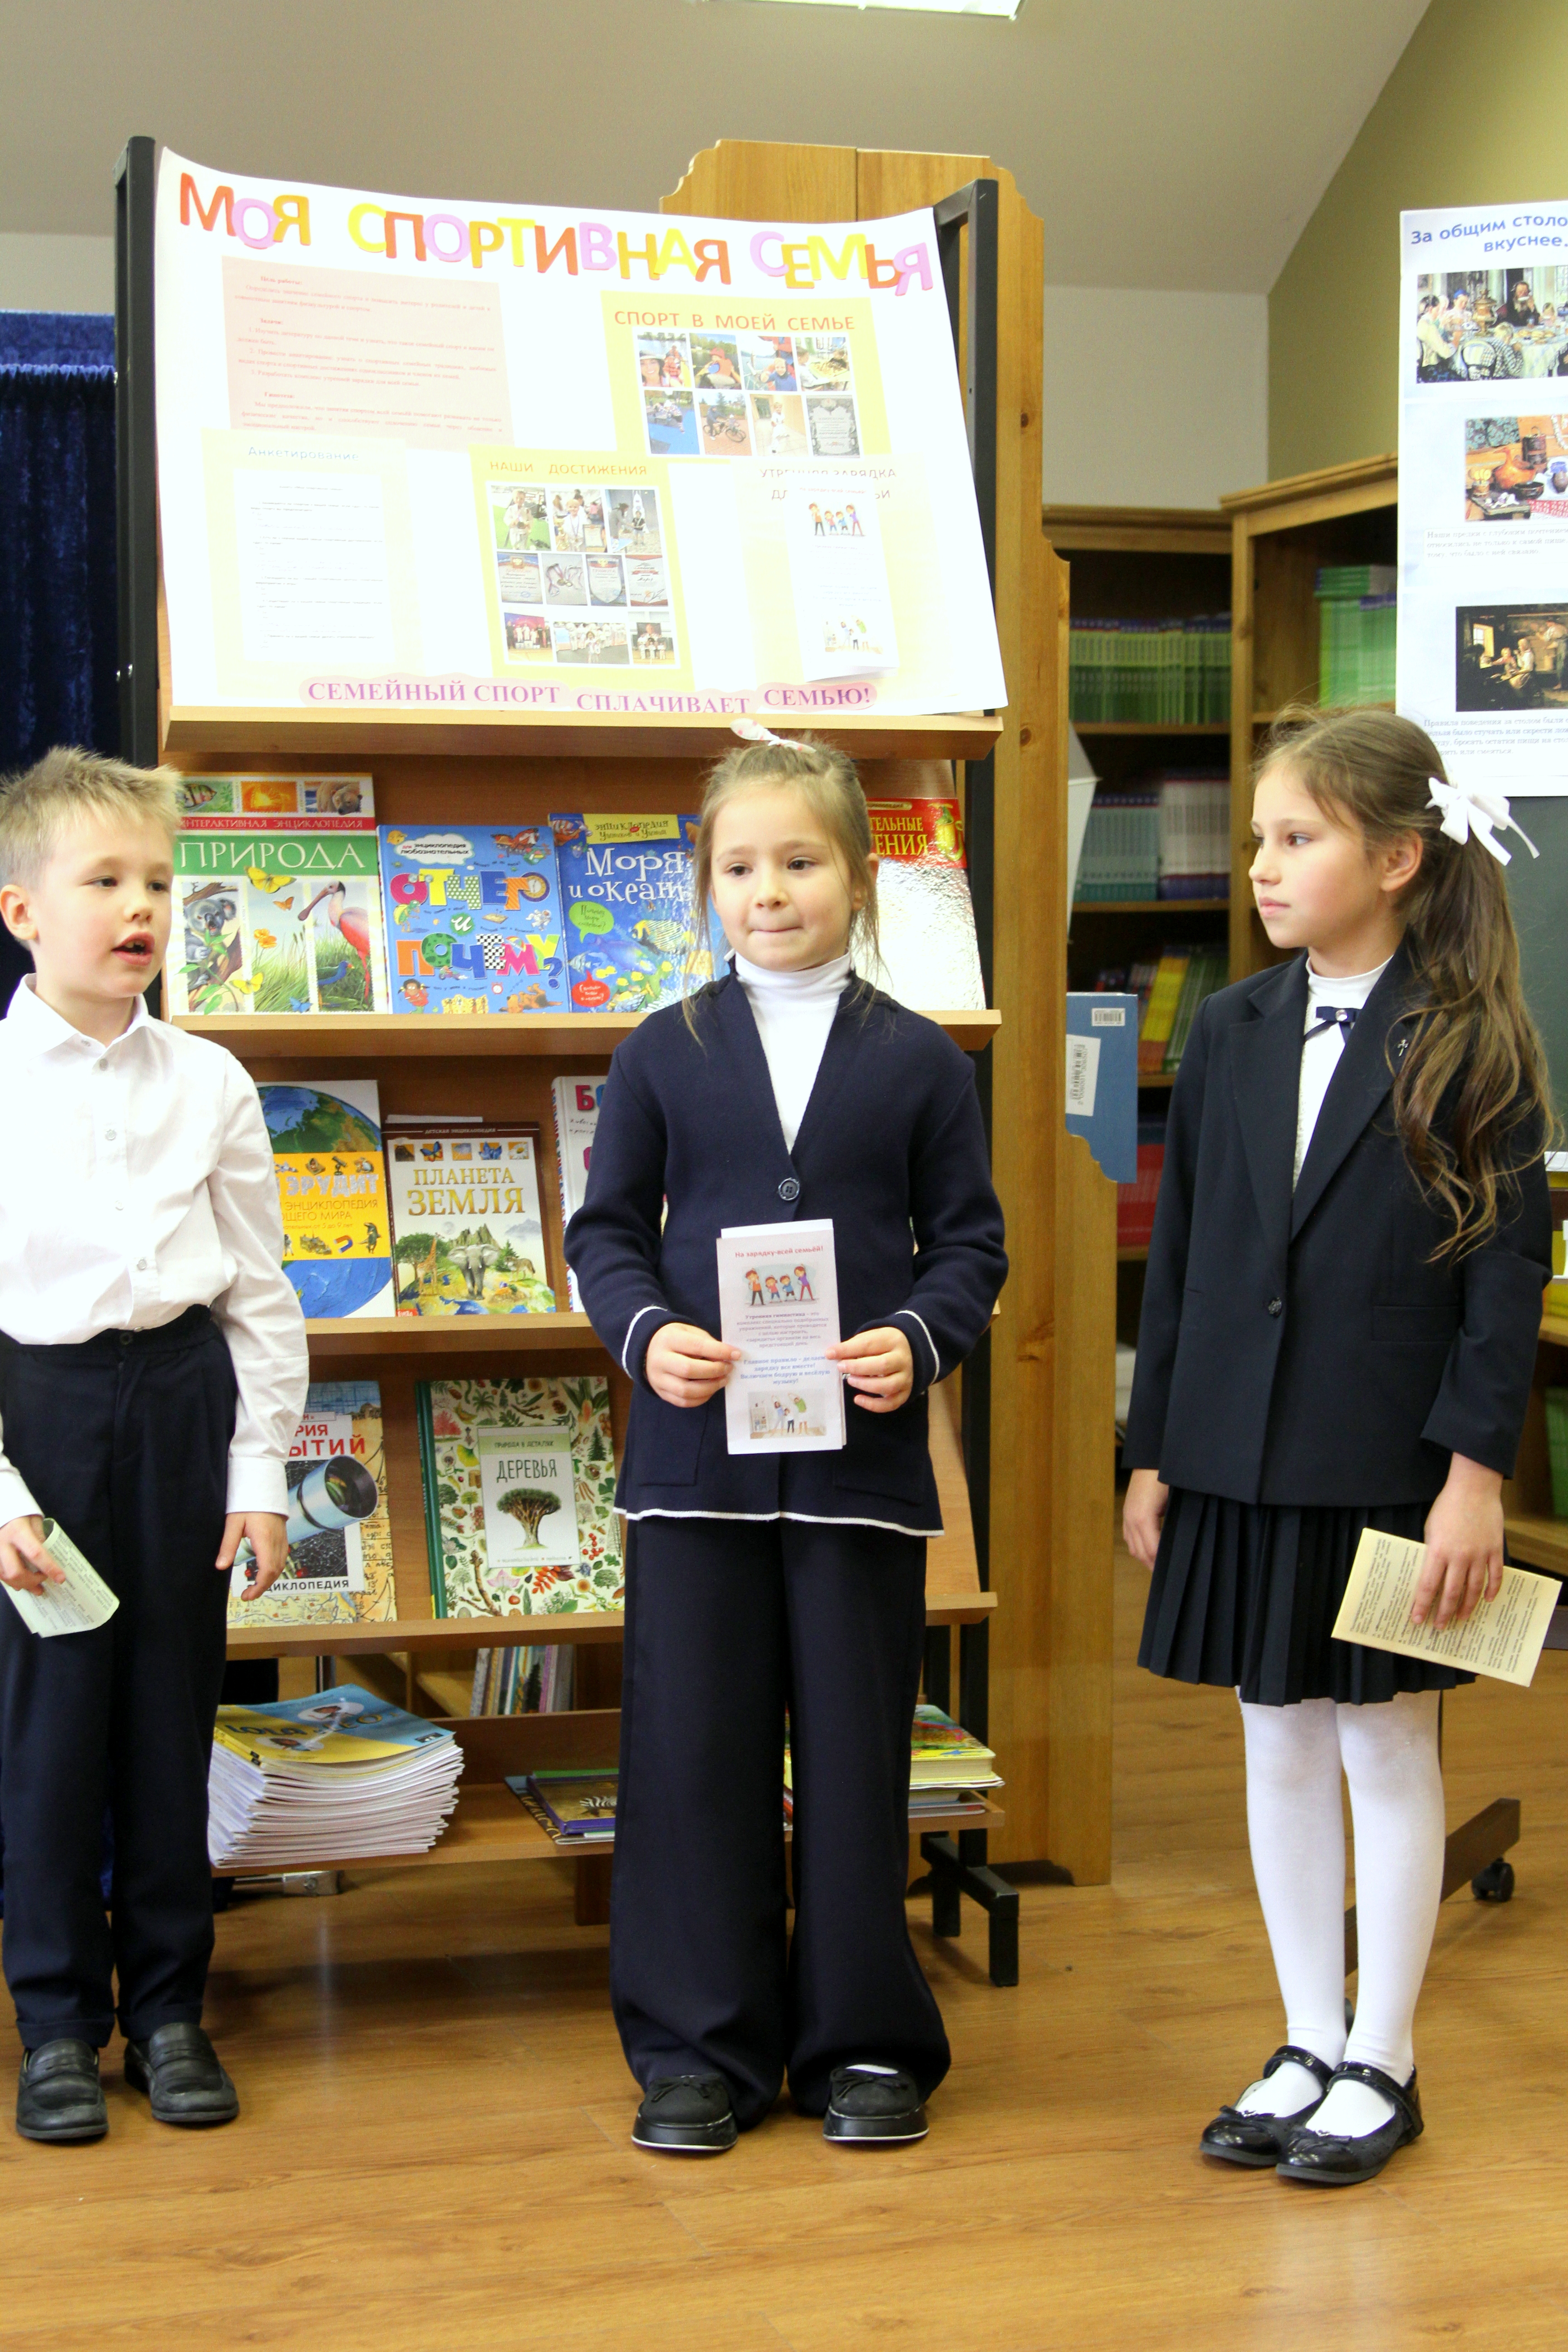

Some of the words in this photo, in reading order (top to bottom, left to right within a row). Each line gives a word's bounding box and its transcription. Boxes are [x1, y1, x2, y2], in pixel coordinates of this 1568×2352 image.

[180, 172, 311, 250] МОЯ
[348, 202, 731, 287] СПОРТИВНАЯ
[750, 230, 934, 297] СЕМЬЯ
[1411, 231, 1432, 245] За
[1440, 219, 1506, 240] общим
[614, 310, 680, 328] СПОРТ
[692, 314, 705, 328] В
[715, 313, 776, 331] МОЕЙ
[787, 315, 856, 331] СЕМЬЕ
[248, 446, 360, 461] Анкетирование
[490, 461, 534, 473] НАШИ
[549, 462, 647, 476] ДОСТИЖЕНИЯ
[308, 678, 466, 702] СЕМЕЙНЫЙ
[474, 684, 561, 705] СПОРТ
[576, 692, 750, 715] СПЛАЧИВАЕТ
[764, 688, 871, 706] СЕМЬЮ!
[273, 819, 363, 828] ЭНЦИКЛОПЕДИЯ
[179, 842, 366, 870] ПРИРОДА
[584, 847, 686, 881] Моря
[389, 867, 551, 911] ОТЧЕГО
[568, 885, 583, 898] и
[396, 932, 564, 990] ПОЧЕМУ?
[286, 1173, 379, 1198] ЭРУДИТ
[413, 1166, 515, 1186] ПЛАНЕТА
[284, 1199, 379, 1211] ЭНЦИКЛОПЕДИЯ
[407, 1187, 526, 1216] ЗЕМЛЯ
[320, 1210, 353, 1221] МИРА
[496, 1459, 557, 1484] ДЕРЕВЬЯ
